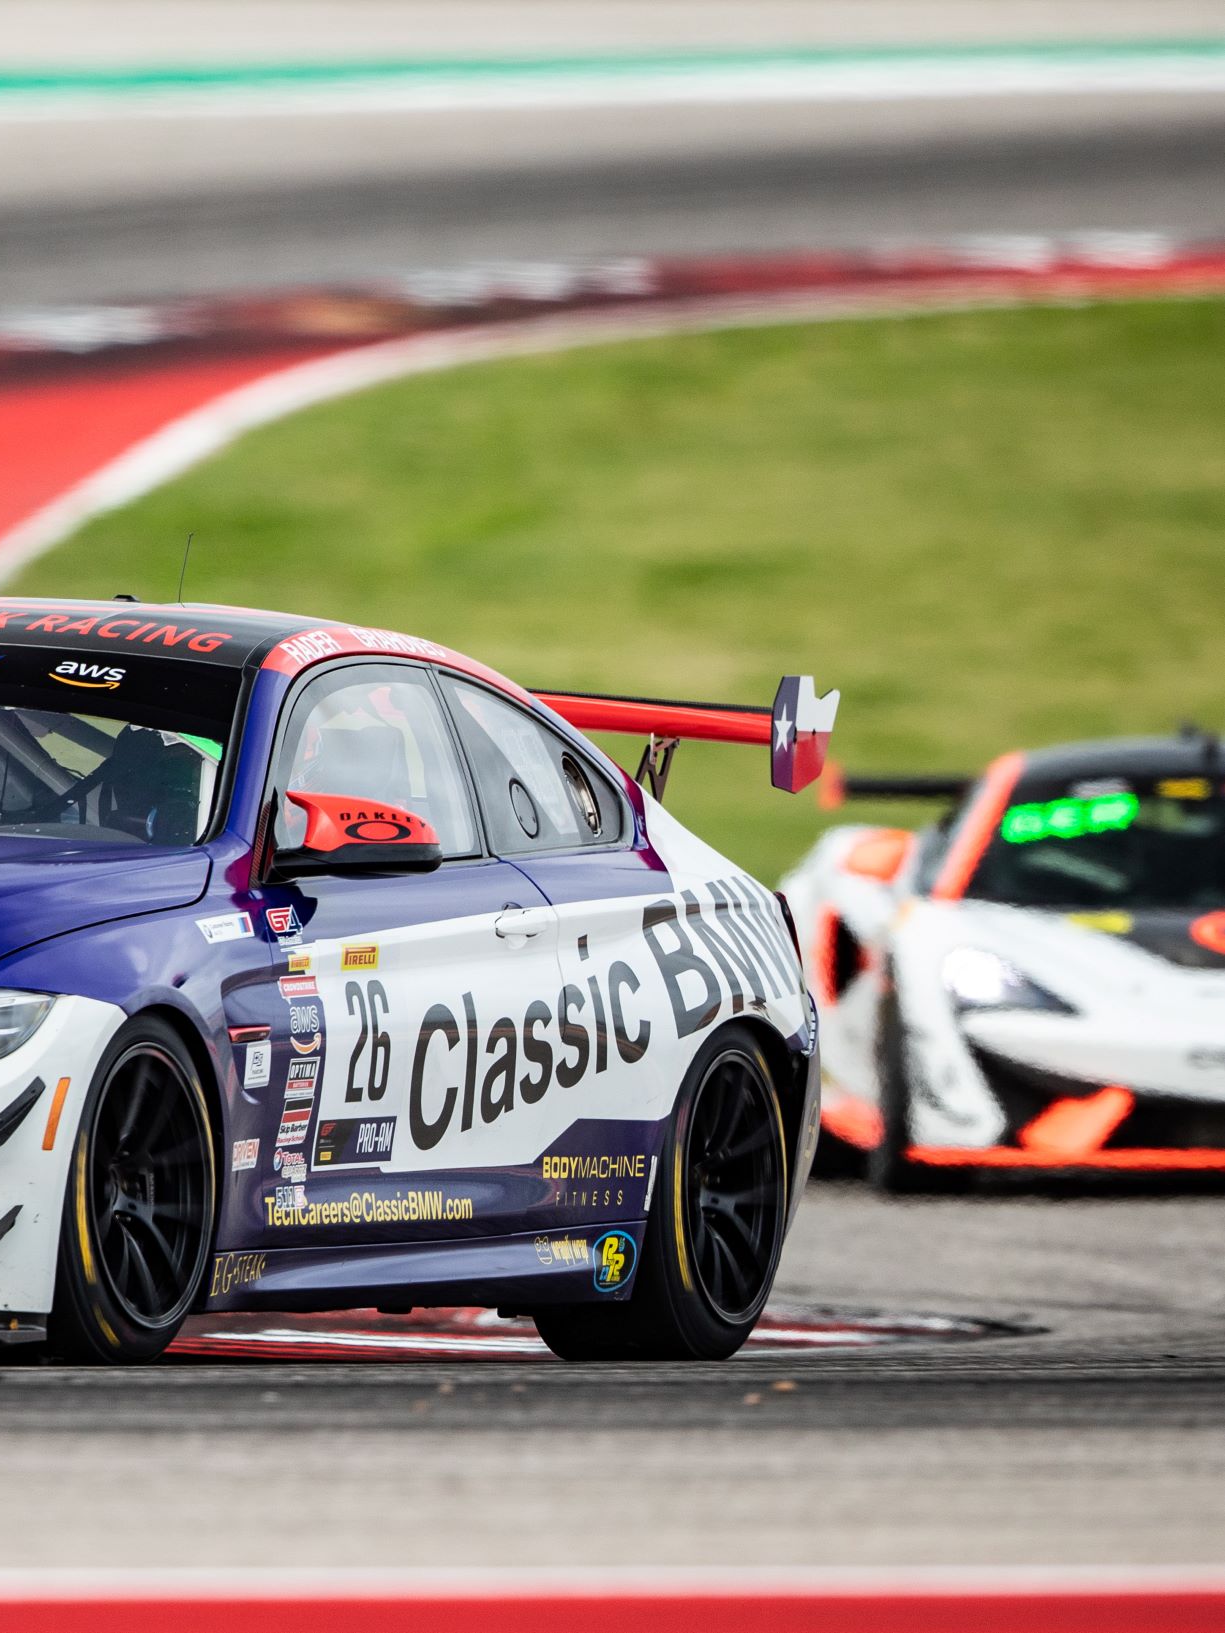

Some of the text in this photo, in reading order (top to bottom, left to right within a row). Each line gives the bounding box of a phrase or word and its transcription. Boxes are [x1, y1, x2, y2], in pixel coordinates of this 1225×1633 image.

[26, 614, 233, 653] RACING
[280, 630, 343, 665] RADER
[55, 660, 127, 682] aws
[339, 811, 426, 828] OAKLEY
[344, 946, 377, 966] PIRELLI
[290, 1005, 319, 1034] aws
[409, 875, 799, 1151] Classic BMW
[344, 979, 391, 1103] 26
[290, 1062, 316, 1079] OPTIMA
[356, 1121, 394, 1153] PRO-AM
[282, 1151, 305, 1165] TOTAL
[556, 1189, 624, 1206] FITNESS
